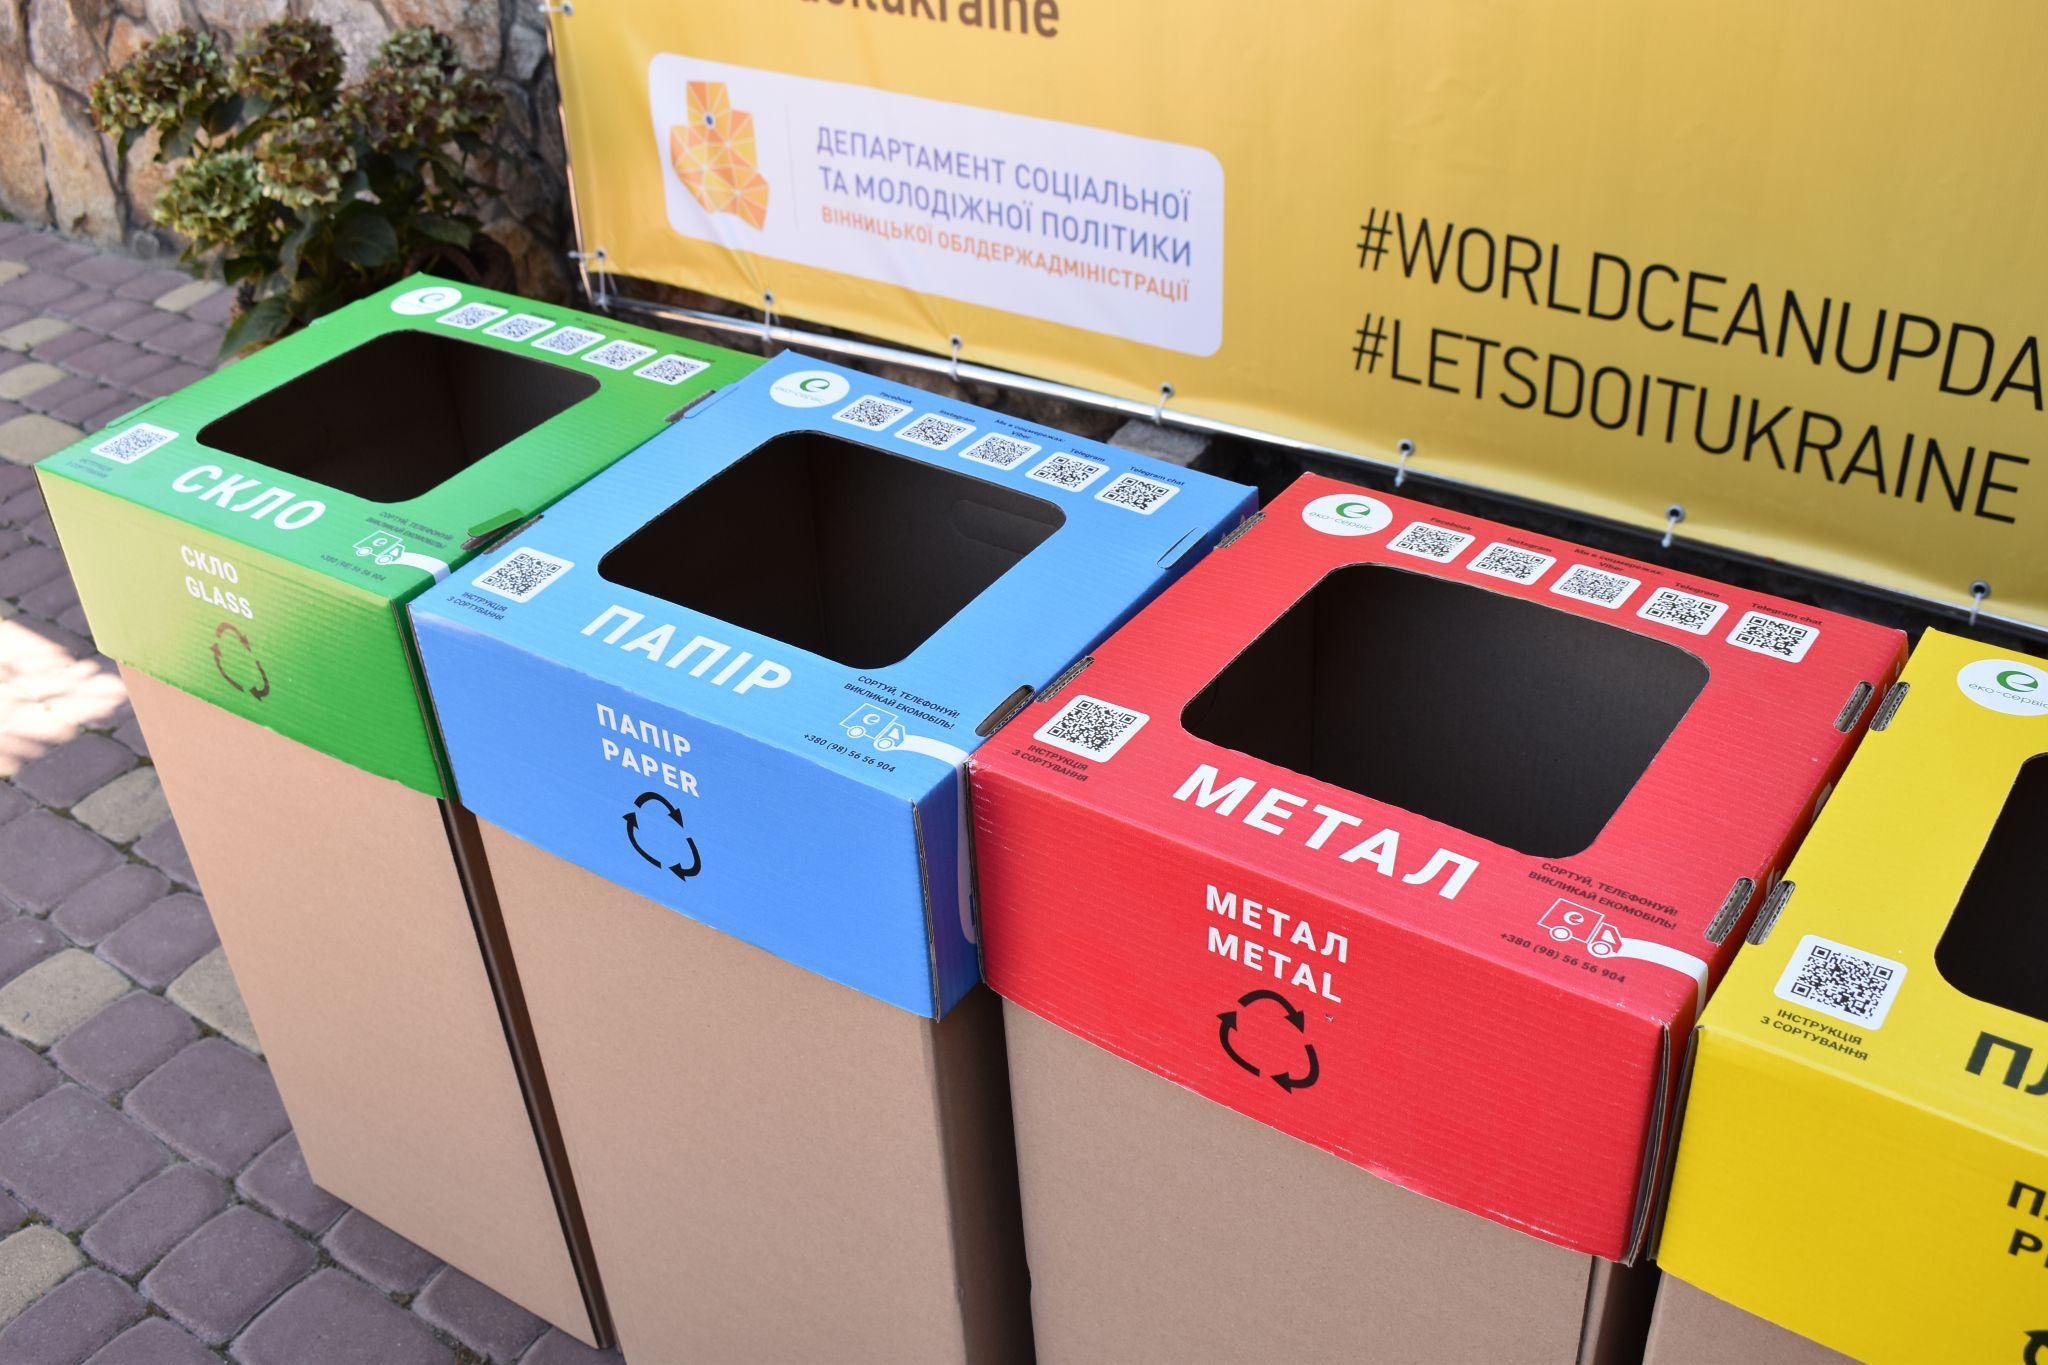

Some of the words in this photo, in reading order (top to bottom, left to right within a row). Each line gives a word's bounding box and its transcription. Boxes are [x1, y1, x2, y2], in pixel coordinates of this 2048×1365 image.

[817, 126, 1006, 184] ДЕПАРТАМЕНТ
[1015, 164, 1191, 222] СОЦІАЛЬНОЇ
[819, 166, 848, 195] ТА
[855, 173, 1033, 233] МОЛОДІЖНОЇ
[1042, 211, 1190, 267] ПОЛІТИКИ
[822, 206, 933, 245] ВІННИЦЬКОЇ
[938, 231, 1190, 303] ОБЛДЕРЖАДМІНІСТРАЦІЇ
[1356, 206, 2044, 411] #WORLDCEANUPDA
[1352, 312, 2031, 524] #LETSDOITUKRAINE
[1070, 447, 1106, 462] Telegram
[1130, 465, 1166, 481] Telegram
[172, 465, 326, 530] СКЛО
[1429, 516, 1473, 532] Facebook
[181, 544, 239, 584] СКЛО
[185, 575, 254, 620] GLASS
[1674, 582, 1721, 599] Telegram
[1751, 602, 1798, 620] Telegram
[1799, 615, 1823, 627] chat
[580, 604, 793, 695] ПАПІР
[843, 682, 896, 708] ВИКЛИКАЙ
[895, 702, 956, 730] ЕКОМОБІЛЬ!
[858, 675, 898, 696] СОРТУЙ,
[899, 690, 961, 719] ТЕЛЕФОНУЙ!
[596, 703, 691, 758] ПАПІР
[803, 734, 828, 747] +380
[827, 742, 848, 756] (98)
[848, 749, 862, 760] 56
[863, 754, 876, 765] 56
[876, 760, 896, 774] 904
[601, 737, 700, 798] PAPER
[1020, 752, 1089, 782] СОРТУВАННЯ
[1027, 744, 1089, 771] ІНСТРУКЦІЯ
[1172, 763, 1480, 900] МЕТАЛ
[1528, 871, 1598, 901] ВИКЛИКАЙ
[1598, 896, 1678, 930] ЕКОМОБІЛЬ!
[1541, 862, 1593, 888] СОРТУЙ,
[1598, 881, 1679, 917] ТЕЛЕФОНУЙ!
[1206, 884, 1348, 964] МЕТАЛ
[1207, 926, 1342, 1004] METAL
[1500, 932, 1532, 949] +380
[1533, 943, 1560, 960] (98)
[1561, 954, 1579, 966] 56
[1581, 960, 1598, 974] 56
[1601, 967, 1626, 984] 904
[1772, 1020, 1869, 1061] СОРТУВАННЯ
[1777, 1008, 1863, 1046] ІНСТРУКЦІЯ
[2007, 1180, 2048, 1221] П
[2007, 1228, 2048, 1269] P
